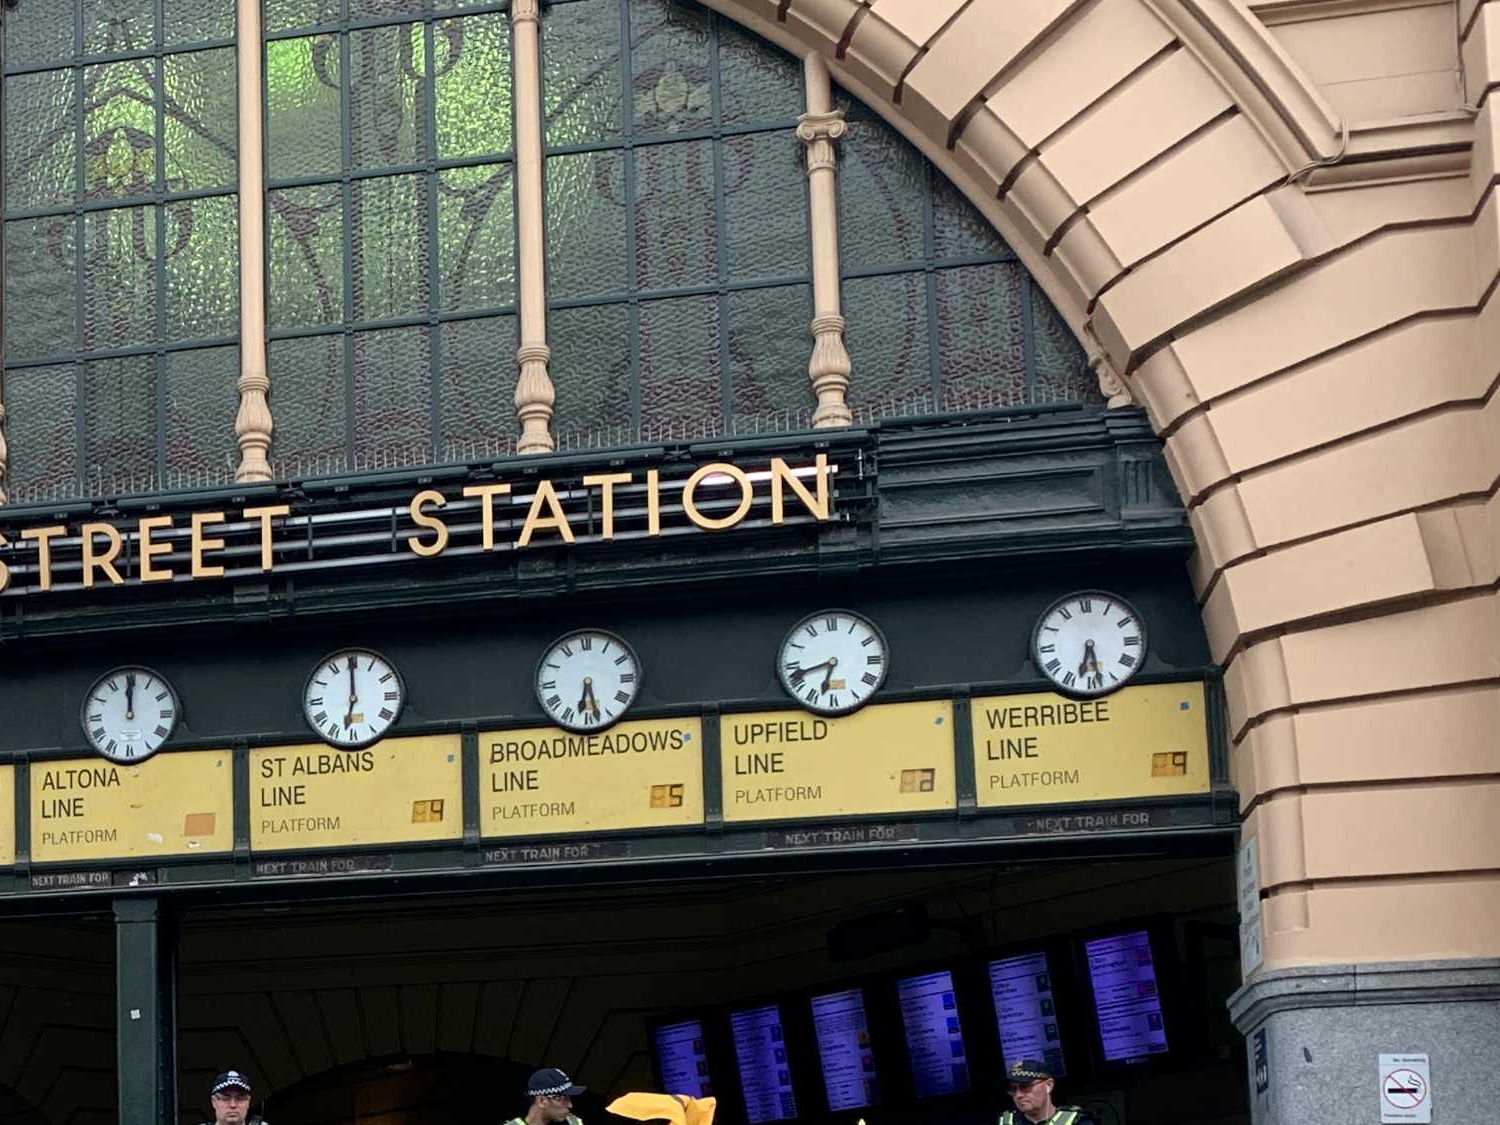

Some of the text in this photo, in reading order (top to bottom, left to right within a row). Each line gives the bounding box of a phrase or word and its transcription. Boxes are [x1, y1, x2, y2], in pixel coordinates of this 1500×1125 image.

[408, 453, 829, 557] STATION
[986, 701, 1110, 730] WERRIBEE
[734, 720, 827, 745] UPFIELD
[490, 729, 683, 763] BROADMEADOWS
[987, 737, 1039, 761] LINE
[261, 751, 374, 778] ST ALBANS
[735, 752, 784, 775] LINE
[42, 768, 120, 790] ALTONA
[491, 769, 539, 792] LINE
[990, 769, 1080, 789] PLATFORM
[261, 785, 306, 807] LINE
[735, 786, 821, 804] PLATFORM
[41, 798, 84, 818] LINE
[492, 801, 575, 820] PLATFORM
[262, 816, 340, 834] PLATFORM
[1035, 813, 1149, 831] NEXT TRAIN FOR
[42, 829, 117, 845] PLATFORM
[785, 827, 894, 845] NEXT TRAIN FOR
[485, 846, 588, 862] NEXT TRAIN FOR
